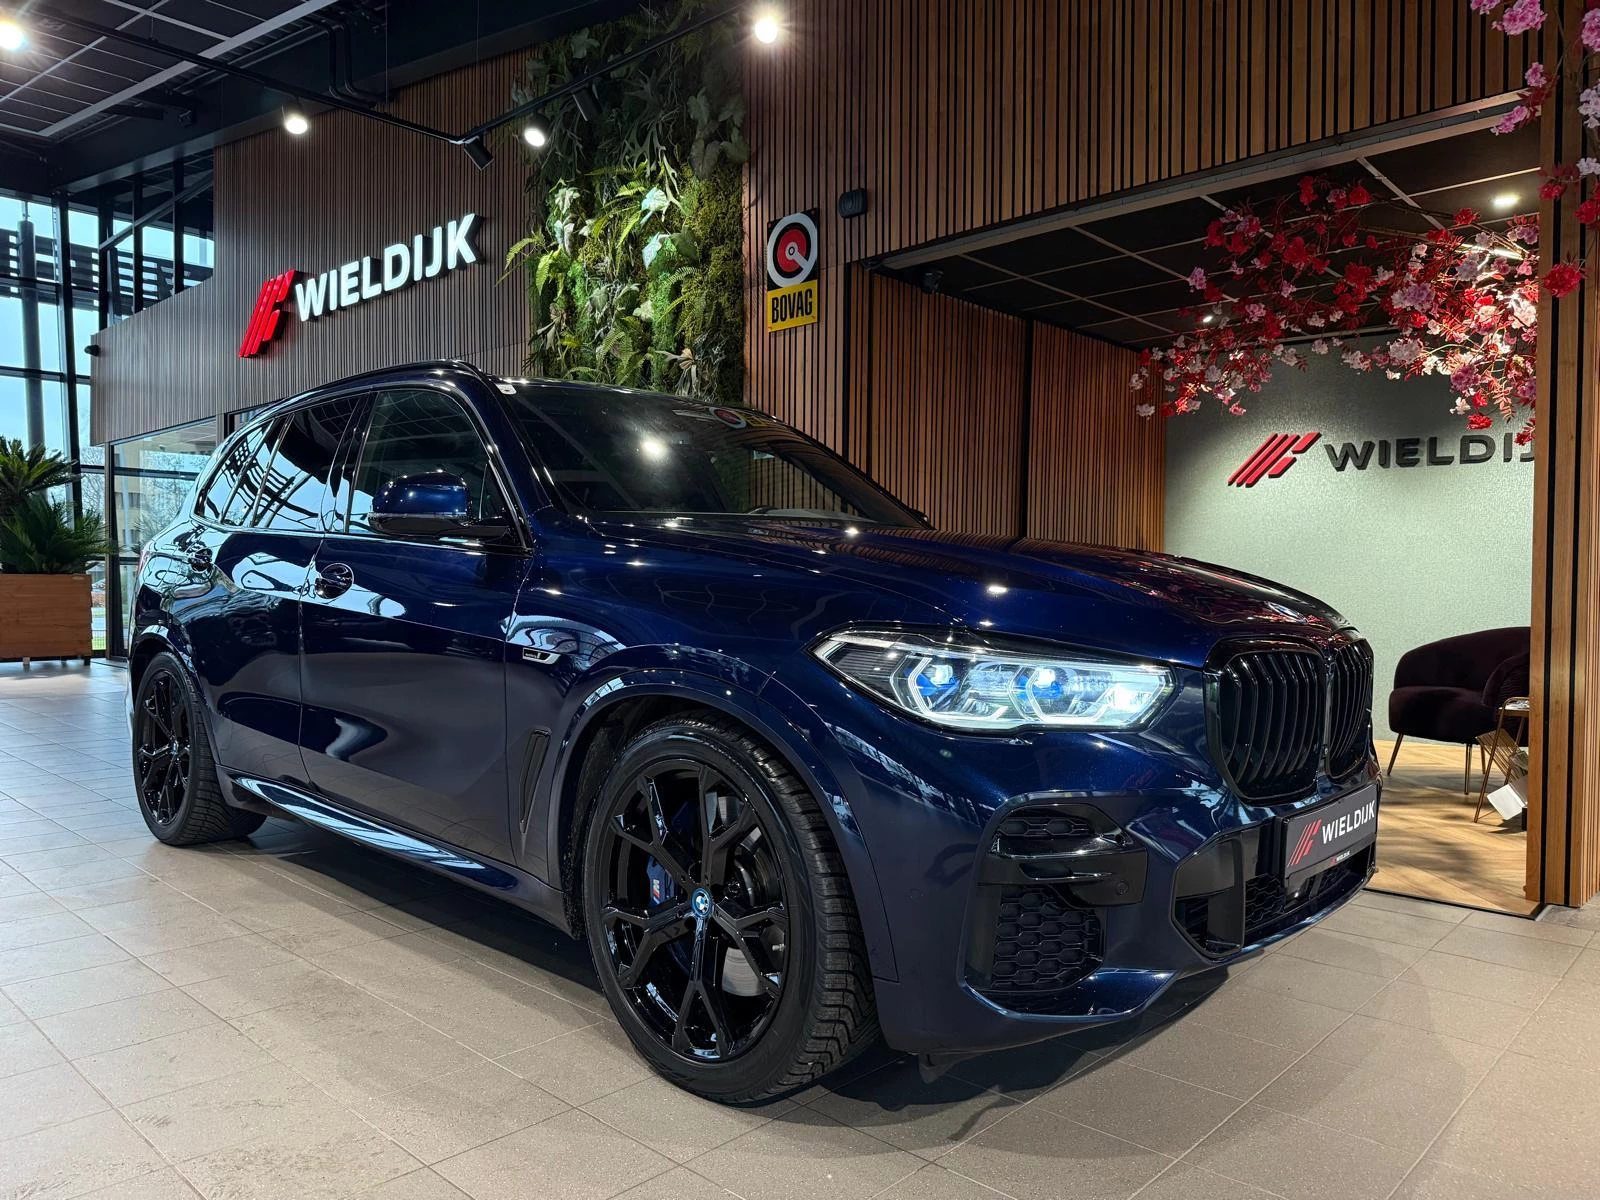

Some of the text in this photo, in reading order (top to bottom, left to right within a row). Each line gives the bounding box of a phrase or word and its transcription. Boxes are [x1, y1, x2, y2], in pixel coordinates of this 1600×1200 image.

[295, 213, 477, 322] WIELDIJK
[771, 288, 813, 323] BOVAG
[1322, 800, 1375, 844] WIELDIJK
